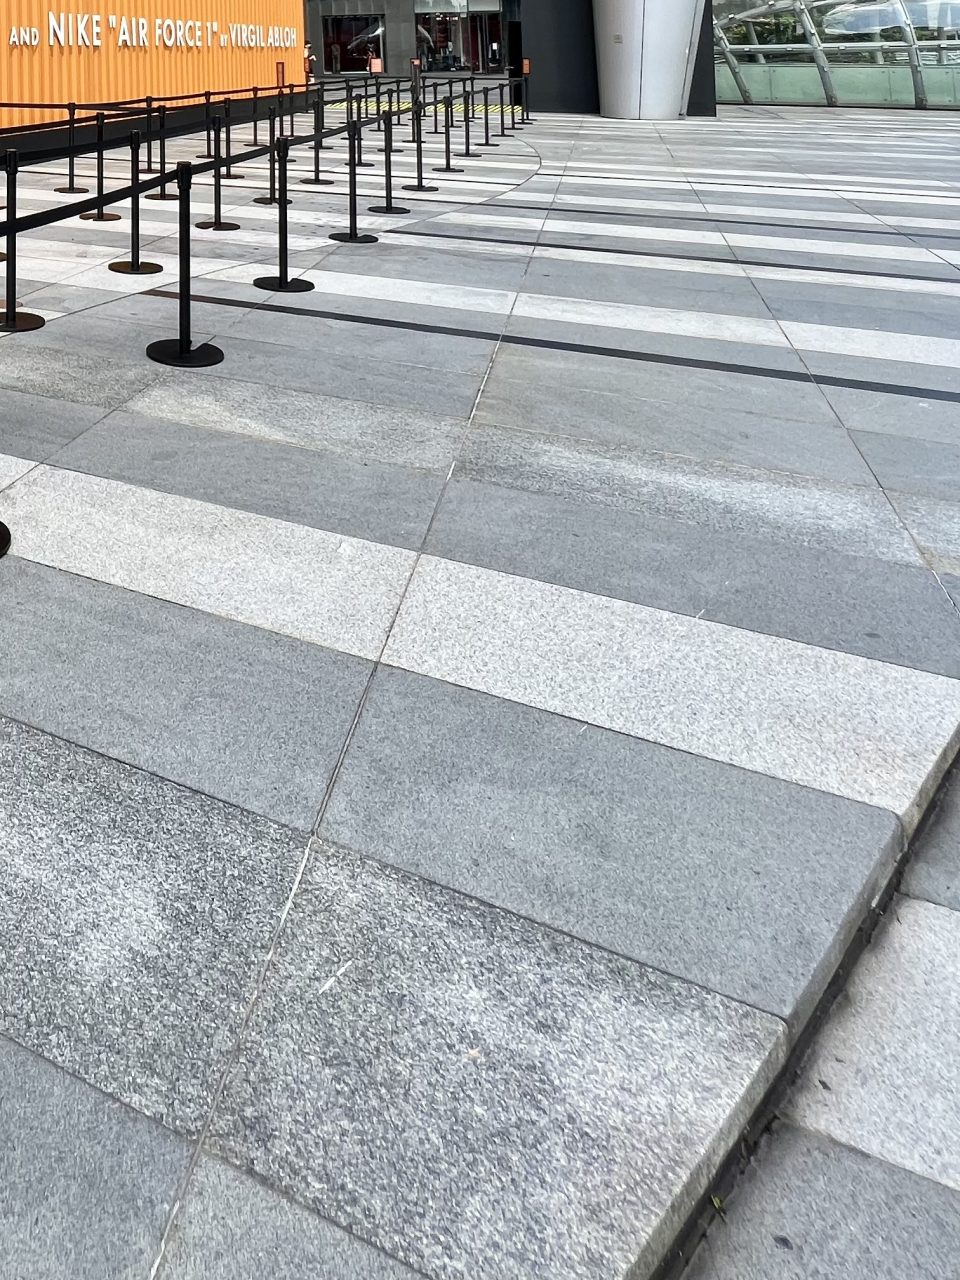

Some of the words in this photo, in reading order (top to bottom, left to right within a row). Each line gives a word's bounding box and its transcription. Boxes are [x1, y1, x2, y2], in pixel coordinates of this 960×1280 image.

[9, 26, 39, 46] AND
[48, 11, 101, 46] NIKE
[155, 18, 202, 47] FORCE
[229, 23, 265, 48] VIRGIL
[267, 26, 297, 48] ABLOH
